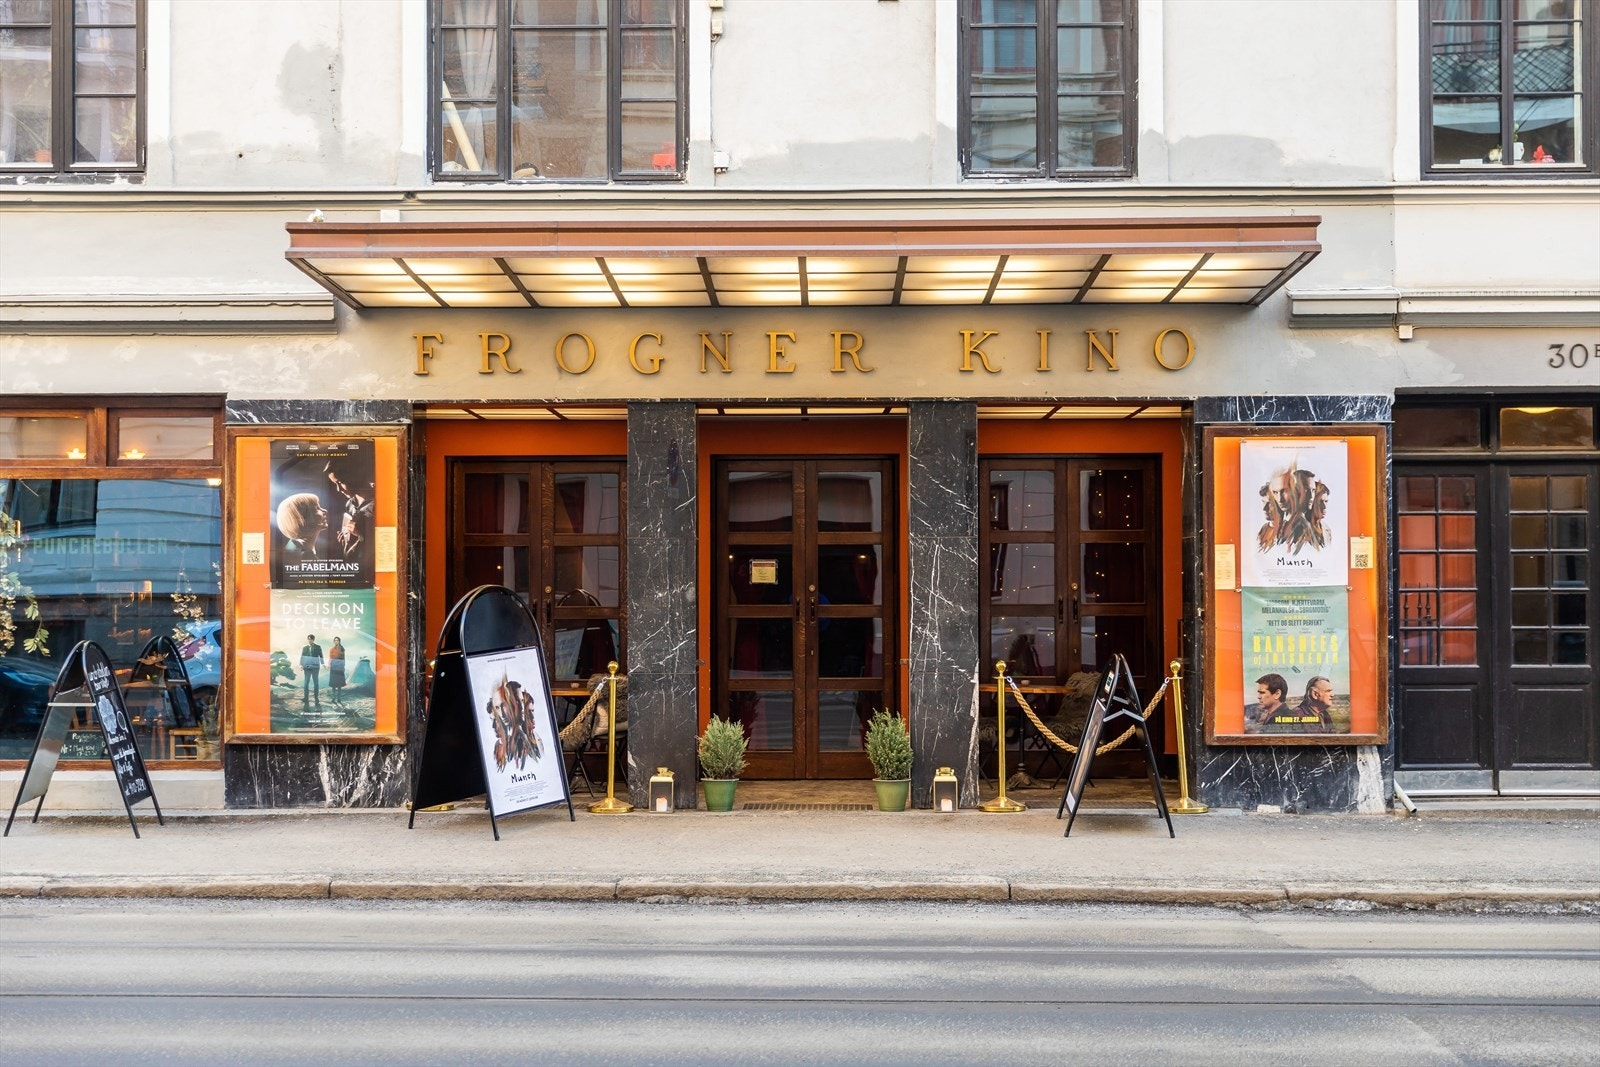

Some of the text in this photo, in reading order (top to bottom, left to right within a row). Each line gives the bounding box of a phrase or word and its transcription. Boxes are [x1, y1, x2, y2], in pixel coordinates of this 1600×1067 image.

[412, 327, 1196, 375] FROGNER KINO
[301, 563, 360, 571] FABELMANS
[282, 602, 364, 615] DECISION
[285, 617, 361, 630] TO LEAVE
